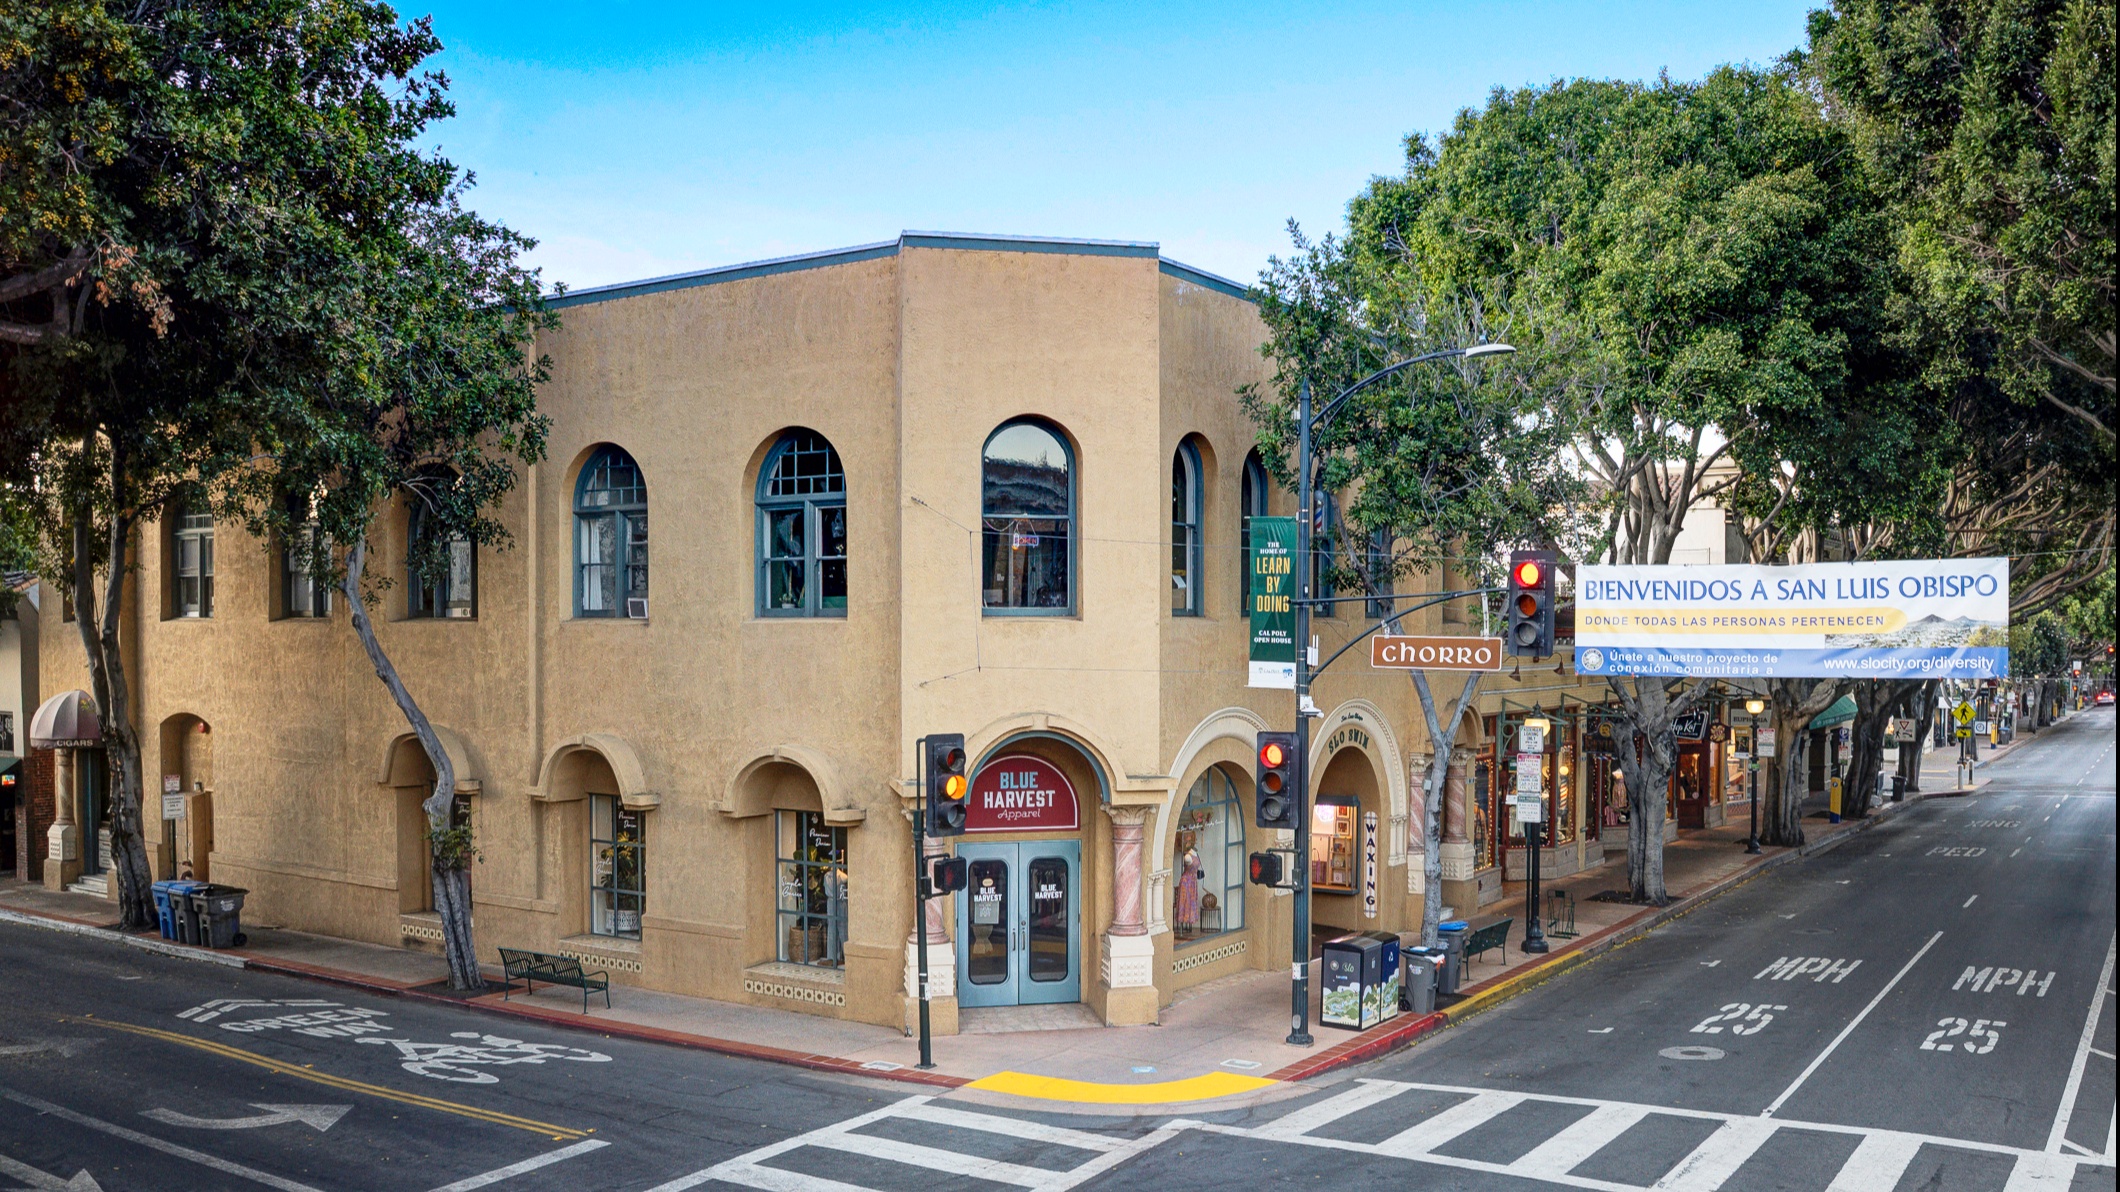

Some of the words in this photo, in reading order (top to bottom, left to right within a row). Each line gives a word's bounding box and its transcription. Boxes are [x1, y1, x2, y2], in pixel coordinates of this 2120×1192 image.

[1256, 557, 1291, 574] LEARN
[1266, 576, 1280, 593] BY
[1585, 579, 1742, 601] BIENVENIDOS
[1750, 579, 1769, 601] A
[1777, 578, 1826, 601] SAN
[1837, 577, 1890, 599] LUIS
[1898, 574, 1998, 598] OBISPO
[1257, 595, 1290, 612] DOING
[1585, 616, 1628, 625] DONDE
[1635, 617, 1677, 626] TODAS
[1682, 617, 1707, 626] LAS
[1713, 617, 1786, 626] PERSONAS
[1792, 616, 1884, 626] PERTENECEN
[1610, 649, 1643, 662] Únete
[1647, 653, 1654, 662] a
[1658, 652, 1702, 663] nuestro
[1707, 653, 1759, 667] proyecto
[1763, 653, 1778, 664] de
[1823, 656, 1994, 673] www.slocity.org/diversity
[1609, 662, 1669, 673] conexión
[1676, 664, 1759, 675] comunitaria
[1766, 667, 1774, 675] a
[56, 739, 93, 747] CIGARS
[1328, 731, 1345, 754] SLO
[1348, 728, 1369, 750] SWIM
[1000, 771, 1038, 789] BLUE
[984, 790, 1055, 808] HARVEST
[997, 809, 1041, 820] Apparel
[1964, 820, 2021, 828] XING
[1925, 846, 1987, 857] PED
[1366, 823, 1376, 906] WAXING
[1035, 891, 1063, 899] HARVEST
[1041, 884, 1057, 892] BLUE
[974, 894, 1002, 902] HARVEST
[1753, 957, 1863, 983] MPH
[1952, 965, 2056, 997] MPH
[219, 1007, 391, 1032] GREEN
[1690, 1003, 1788, 1035] 25
[291, 1020, 394, 1038] WAY
[1919, 1016, 2007, 1054] 25
